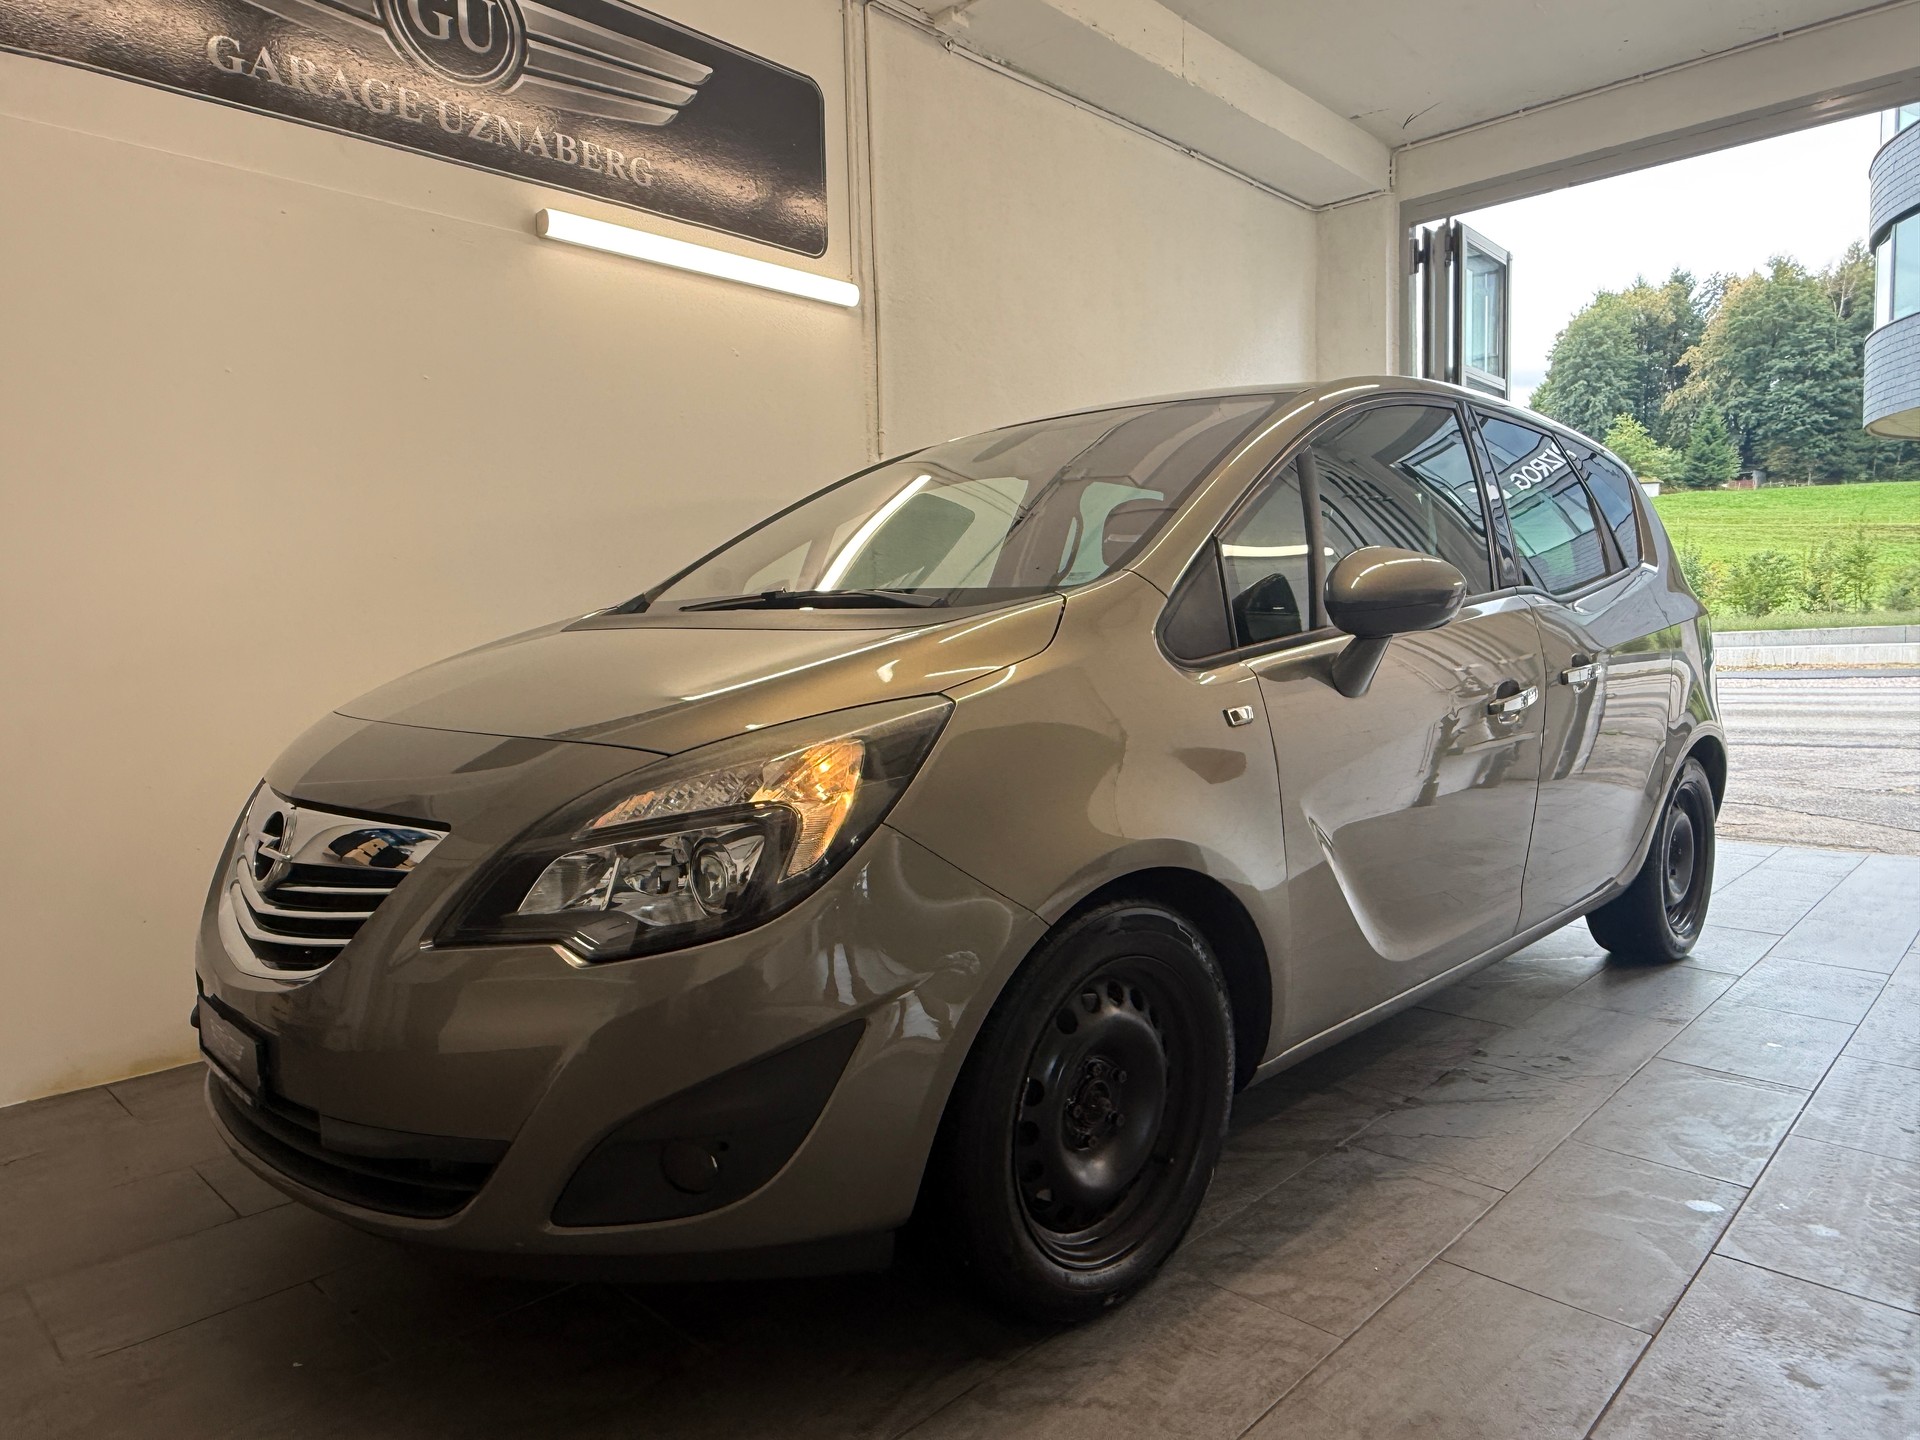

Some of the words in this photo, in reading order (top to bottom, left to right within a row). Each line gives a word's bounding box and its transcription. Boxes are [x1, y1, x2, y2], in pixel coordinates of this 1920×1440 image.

[407, 0, 497, 54] GU
[207, 35, 423, 124] GARAGE
[436, 98, 654, 188] UZNABERG
